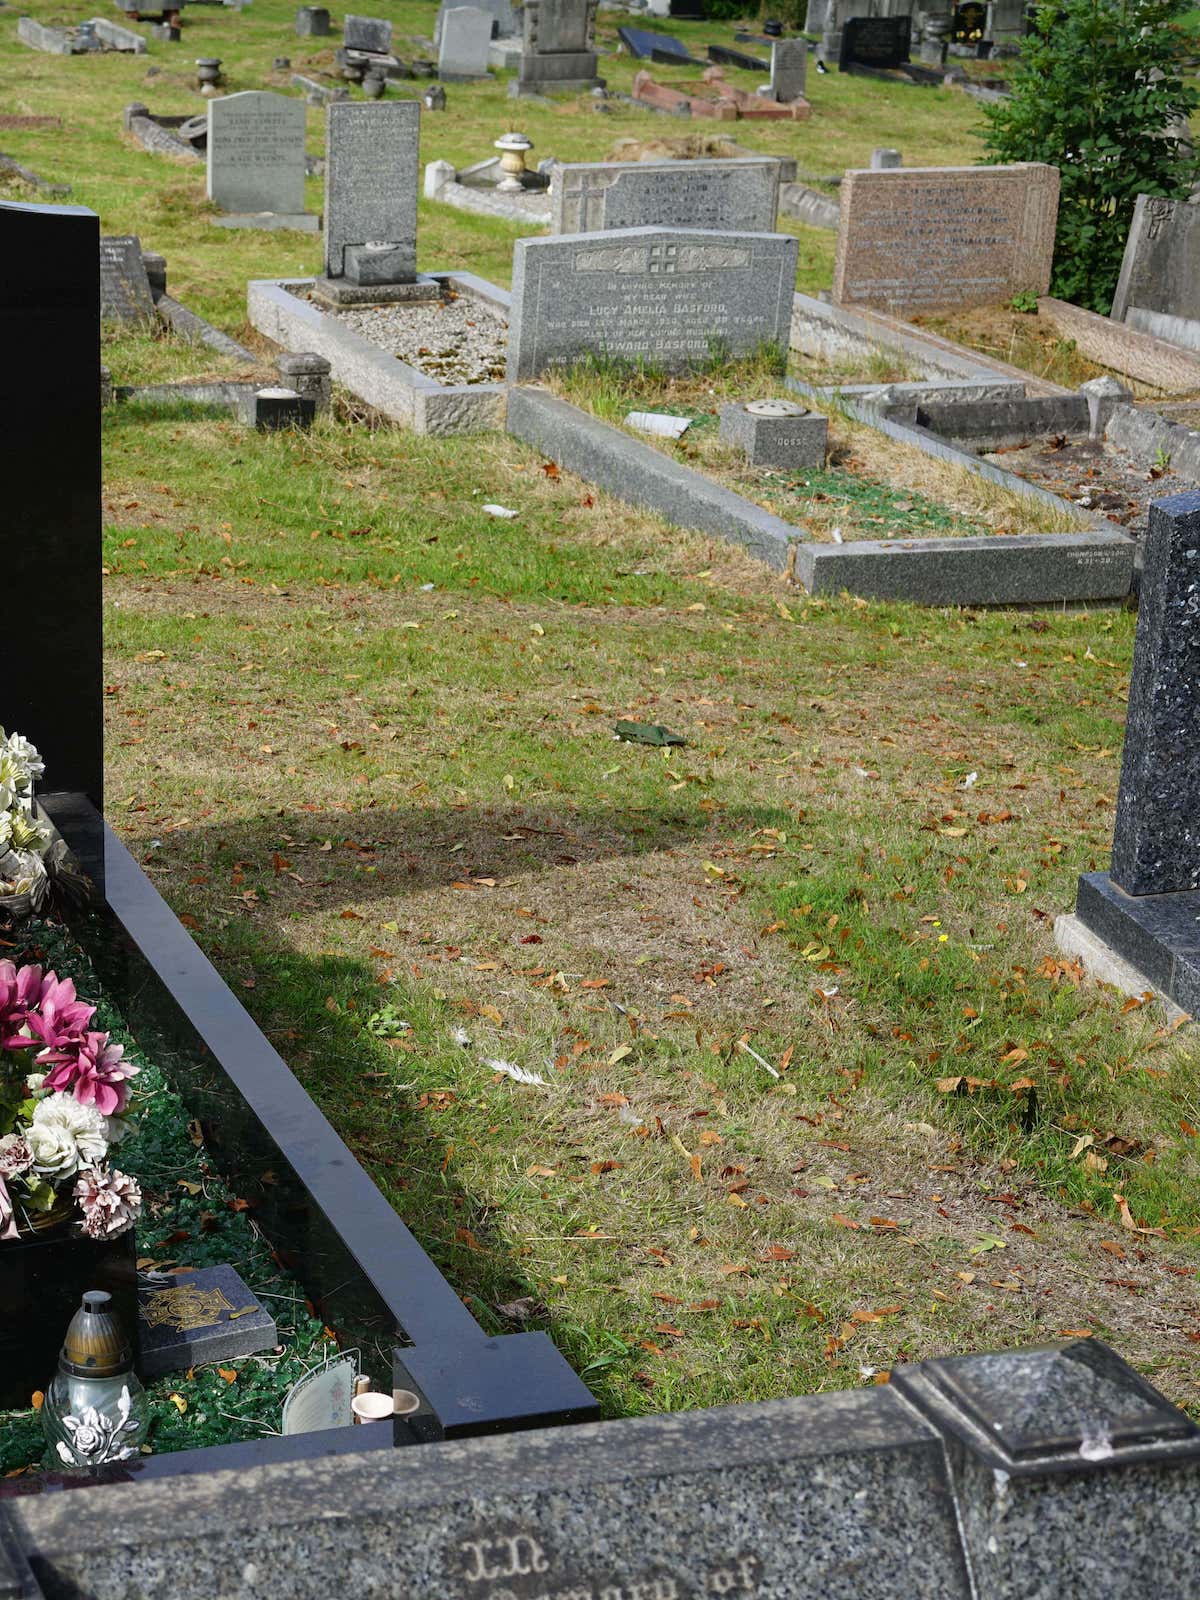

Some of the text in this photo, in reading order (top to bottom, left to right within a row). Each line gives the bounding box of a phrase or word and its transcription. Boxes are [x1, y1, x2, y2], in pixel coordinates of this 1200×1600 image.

[589, 306, 619, 317] LUCY
[623, 303, 667, 315] AMELIA
[599, 341, 650, 351] EDWARD
